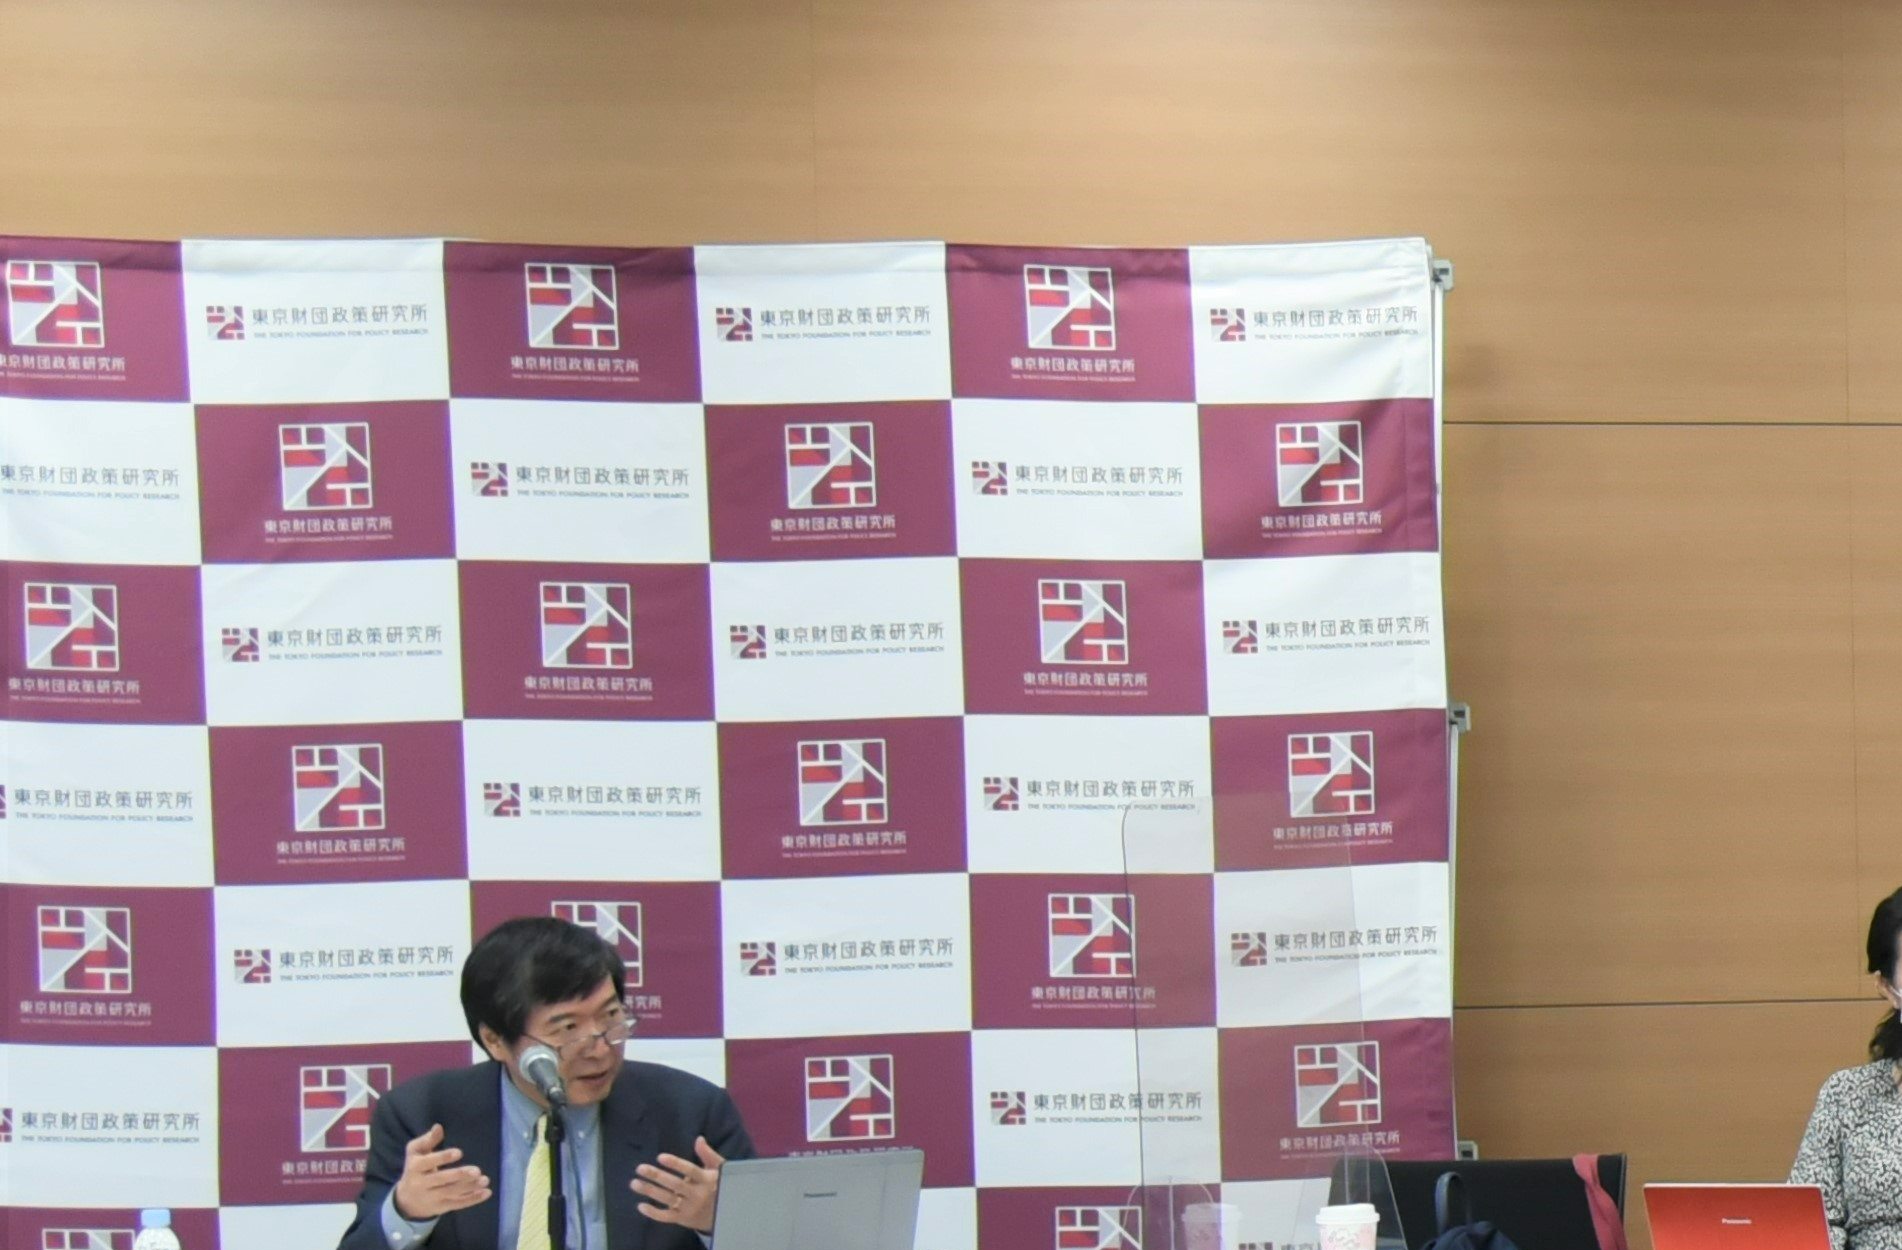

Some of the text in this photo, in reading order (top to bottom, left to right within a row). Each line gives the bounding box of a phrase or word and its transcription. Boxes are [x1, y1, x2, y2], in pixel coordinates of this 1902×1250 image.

[253, 303, 426, 327] 東京財団政策研究所
[761, 305, 929, 327] 東京財団政策研究所
[1254, 305, 1417, 329] 東京財団政策研究所
[511, 356, 638, 372] 東京財団政策研究所
[1011, 357, 1135, 372] 東京財団政策研究所
[1, 464, 178, 487] 東京財団政策研究所
[517, 465, 688, 487] 東京財団政策研究所
[1016, 464, 1182, 485] 東京財団政策研究所
[264, 517, 392, 533] 東京財団政策研究所
[770, 515, 895, 532] 東京財団政策研究所
[1262, 511, 1381, 529] 東京財団政策研究所
[268, 624, 441, 648] 東京財団政策研究所
[775, 621, 943, 644] 東京財団政策研究所
[1266, 614, 1428, 640] 東京財団政策研究所
[8, 677, 139, 694] 東京財団政策研究所
[524, 676, 652, 691] 東京財団政策研究所
[1024, 672, 1147, 686] 東京財団政策研究所
[529, 785, 700, 804] 東京財団政策研究所
[1027, 780, 1193, 797] 東京財団政策研究所
[15, 788, 192, 810] 東京財団政策研究所
[277, 837, 405, 854] 東京財団政策研究所
[782, 831, 906, 849] 東京財団政策研究所
[1275, 924, 1436, 951] 東京財団政策研究所
[280, 945, 452, 969] 東京財団政策研究所
[785, 937, 952, 961] 東京財団政策研究所
[20, 1001, 151, 1016] 東京財団政策研究所
[1034, 1091, 1201, 1111] 東京財団政策研究所
[22, 1111, 198, 1131] 東京財団政策研究所
[282, 1159, 367, 1175] 東京財団政策
